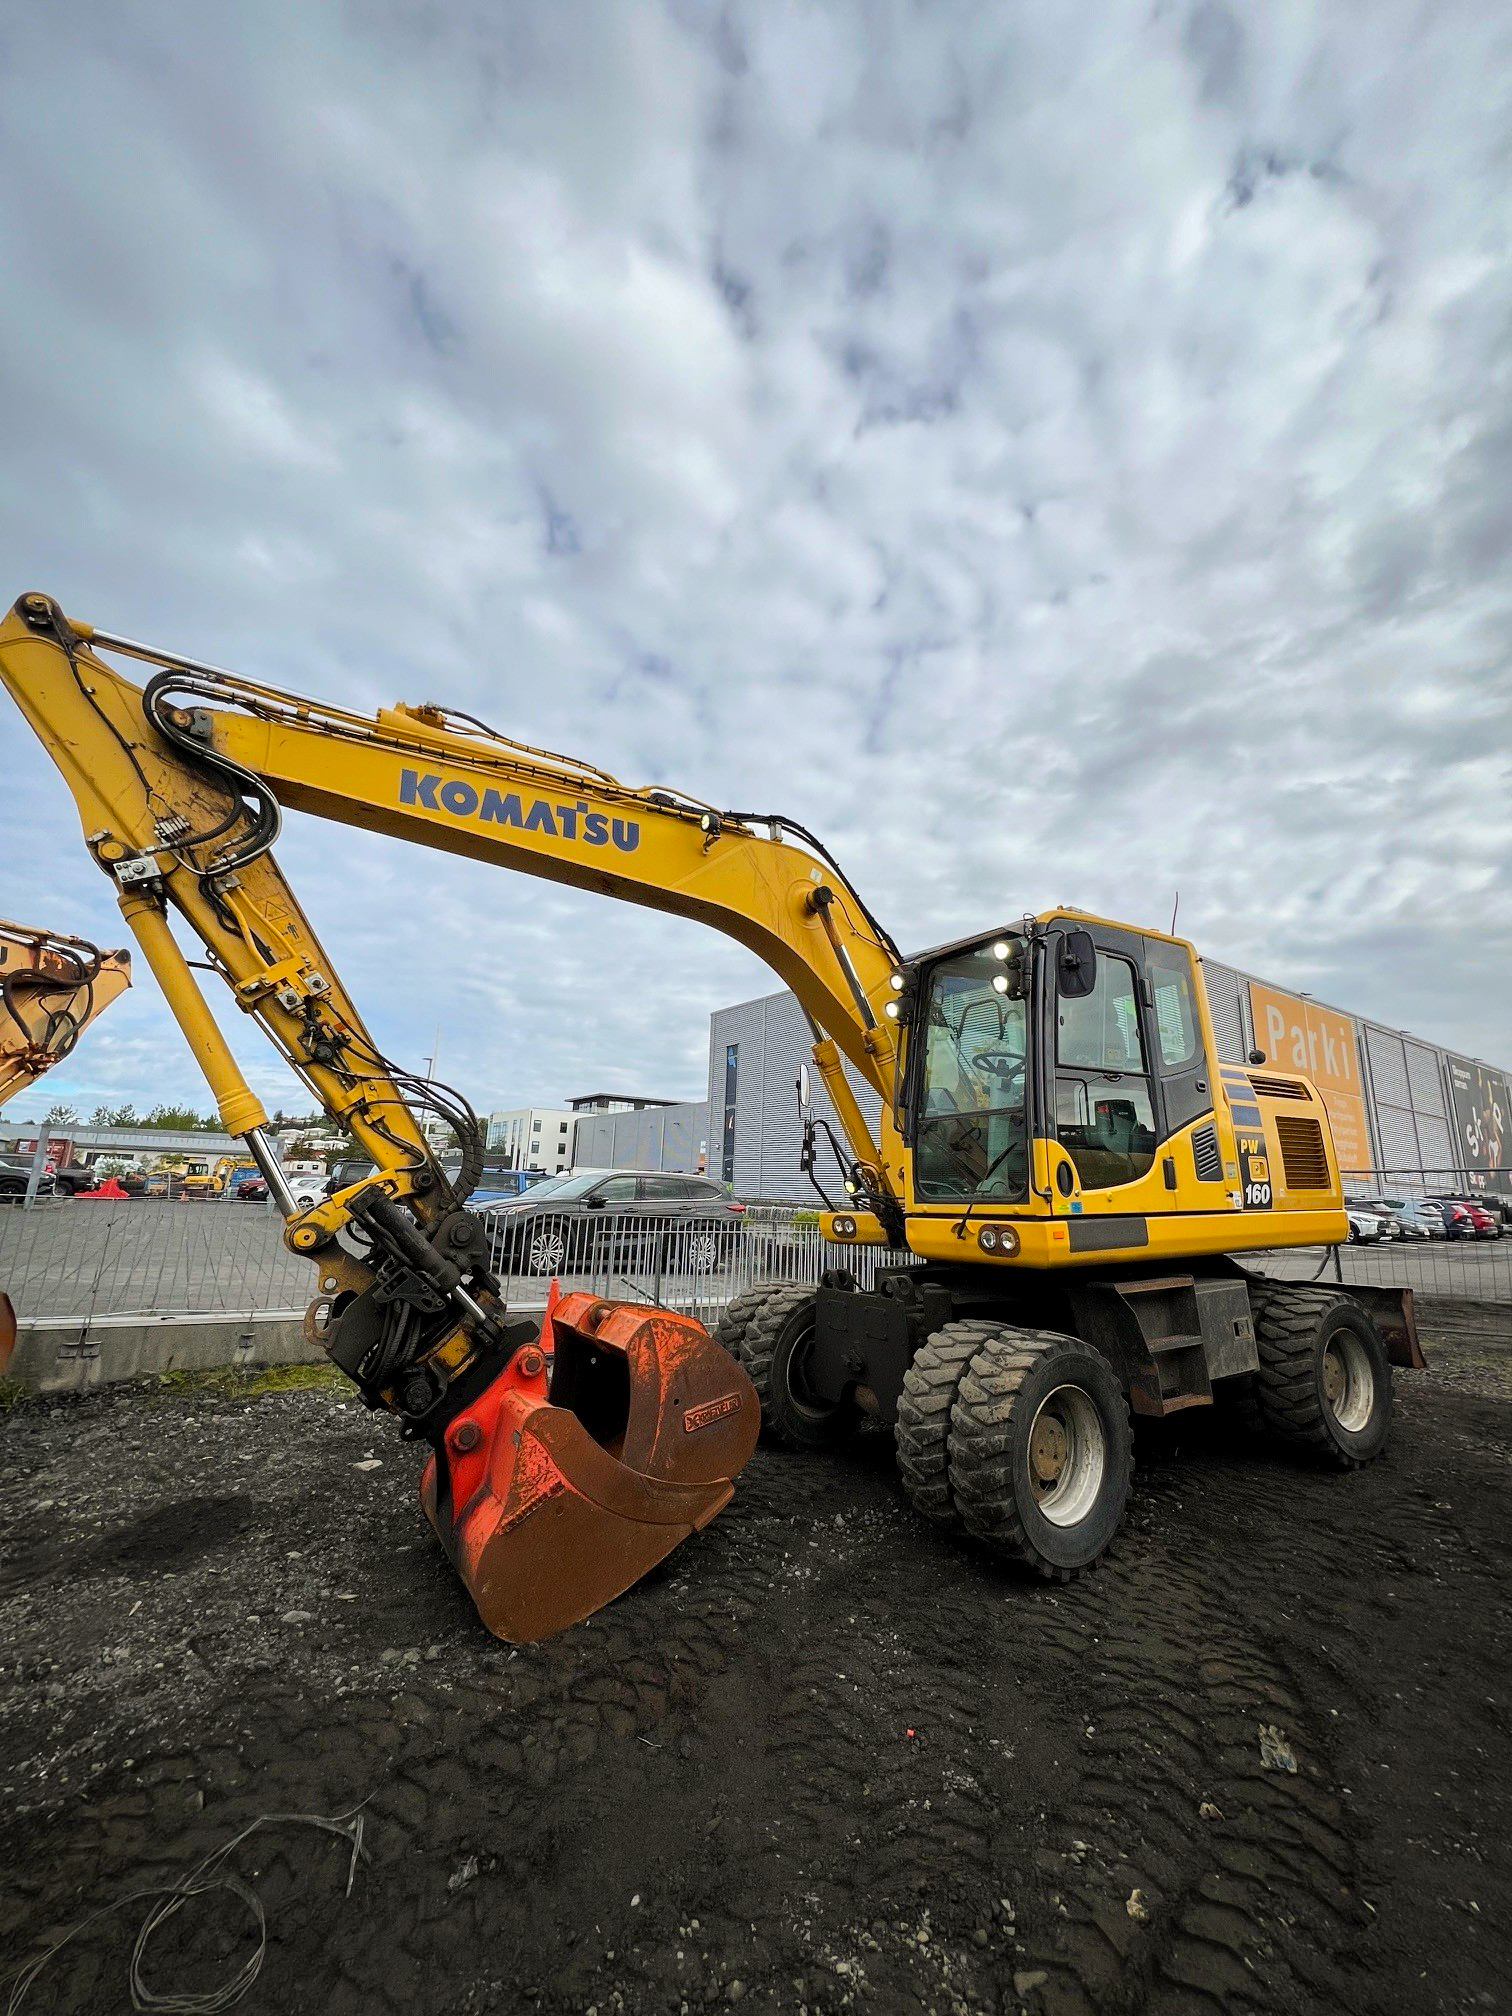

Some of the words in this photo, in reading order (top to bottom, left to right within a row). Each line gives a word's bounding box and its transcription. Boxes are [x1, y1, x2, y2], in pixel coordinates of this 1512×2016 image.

[400, 768, 641, 852] KOMATSU
[1265, 1004, 1350, 1080] Parki
[1240, 1138, 1259, 1154] PW
[1245, 1183, 1271, 1205] 160
